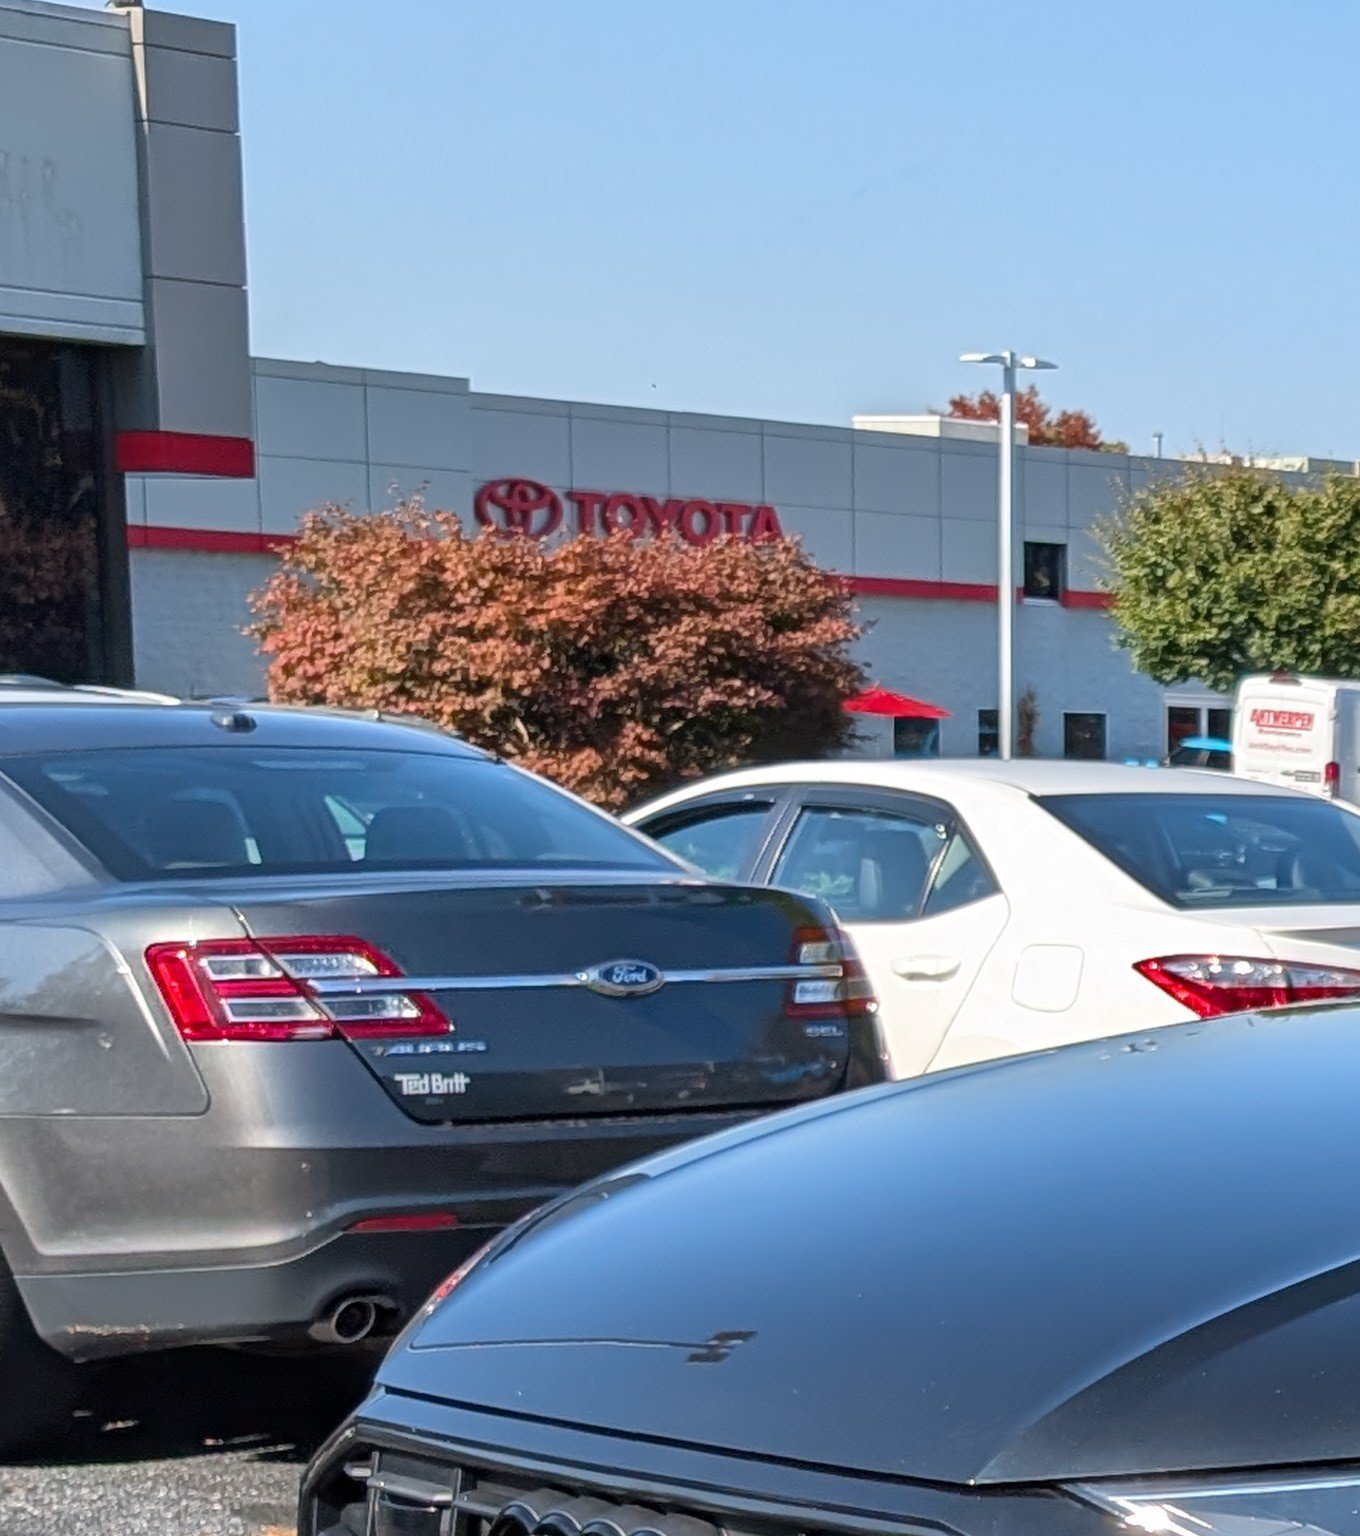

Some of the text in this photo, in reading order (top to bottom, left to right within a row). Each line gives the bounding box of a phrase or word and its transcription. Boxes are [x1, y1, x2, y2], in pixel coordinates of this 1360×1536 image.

[565, 491, 784, 547] TOYOTA
[612, 966, 648, 984] Ford
[394, 1072, 471, 1096] Ted Britt
